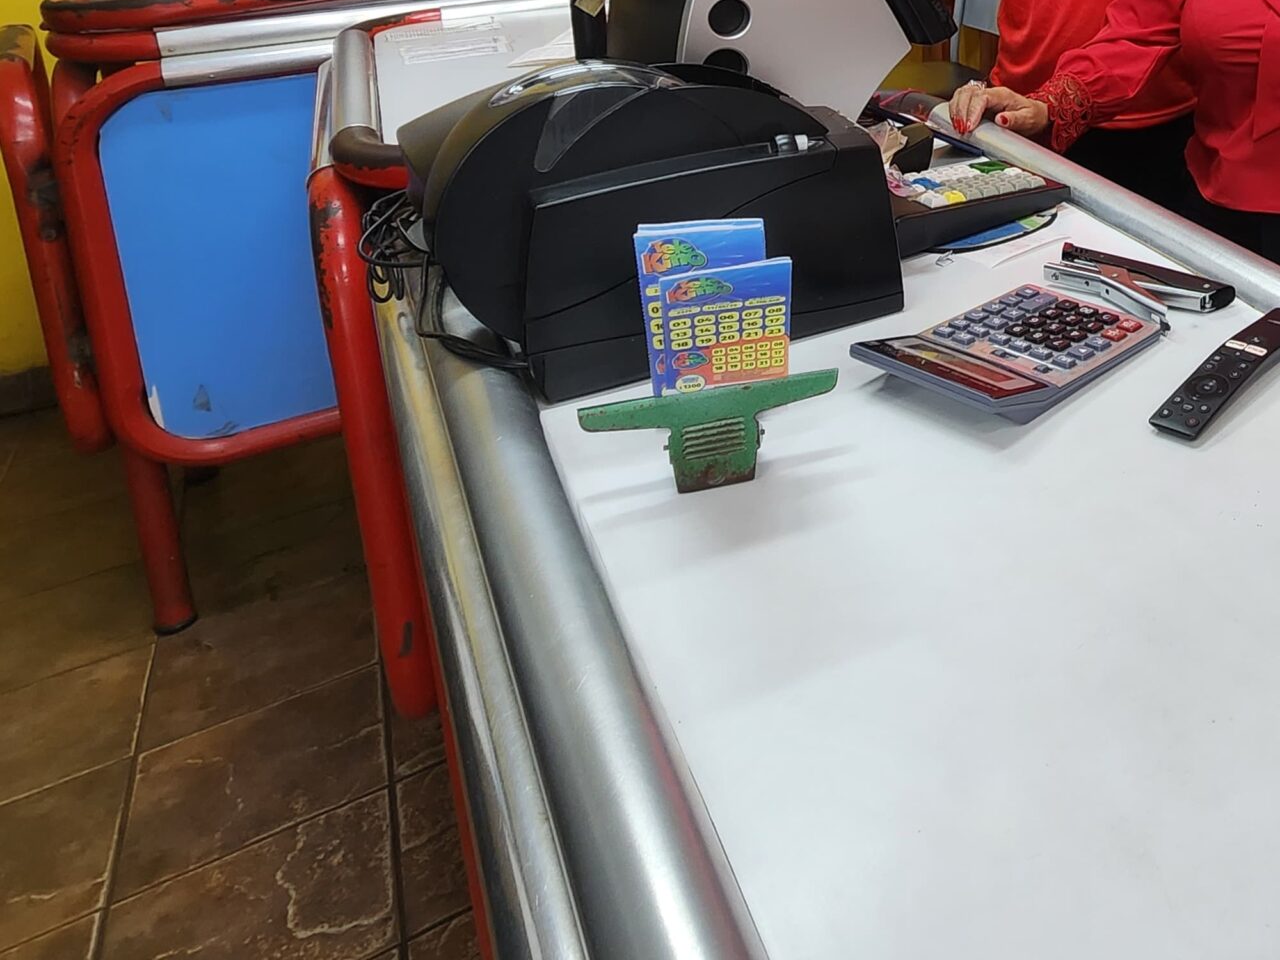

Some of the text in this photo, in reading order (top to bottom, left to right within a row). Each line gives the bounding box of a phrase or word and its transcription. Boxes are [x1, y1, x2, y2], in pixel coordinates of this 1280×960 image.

[744, 307, 783, 318] 07 08
[720, 330, 759, 342] 20 21
